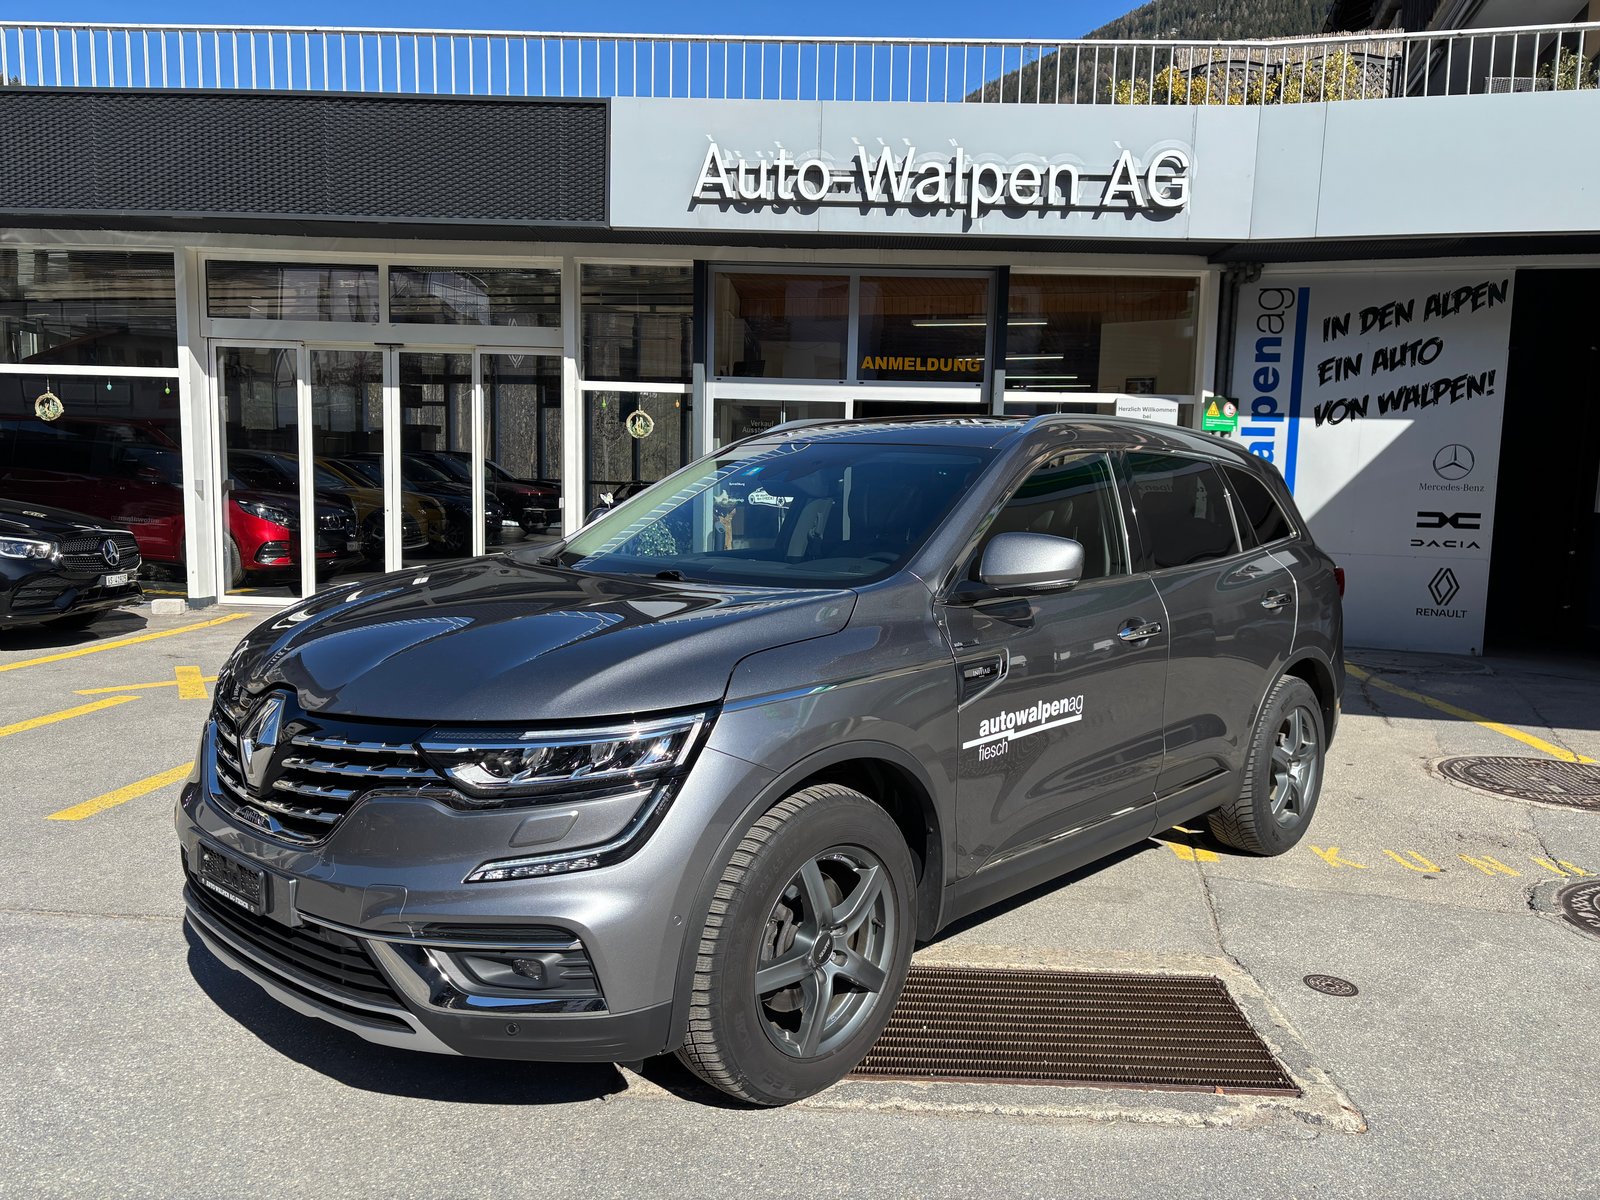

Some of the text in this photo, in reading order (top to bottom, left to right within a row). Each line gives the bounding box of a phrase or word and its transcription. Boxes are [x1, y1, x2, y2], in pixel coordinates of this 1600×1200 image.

[1102, 149, 1190, 208] AG
[1323, 279, 1509, 343] IN DEN ALPEN
[861, 355, 981, 372] ANMELDUNG
[1317, 336, 1444, 387] EIN AUTO
[1313, 369, 1497, 428] VON WALPEN!
[1418, 482, 1485, 493] Mercedes-Benz
[1410, 539, 1481, 549] DACIA
[1415, 607, 1468, 618] RENAULT
[979, 694, 1084, 737] autowalpenag
[978, 738, 1008, 762] fiesch
